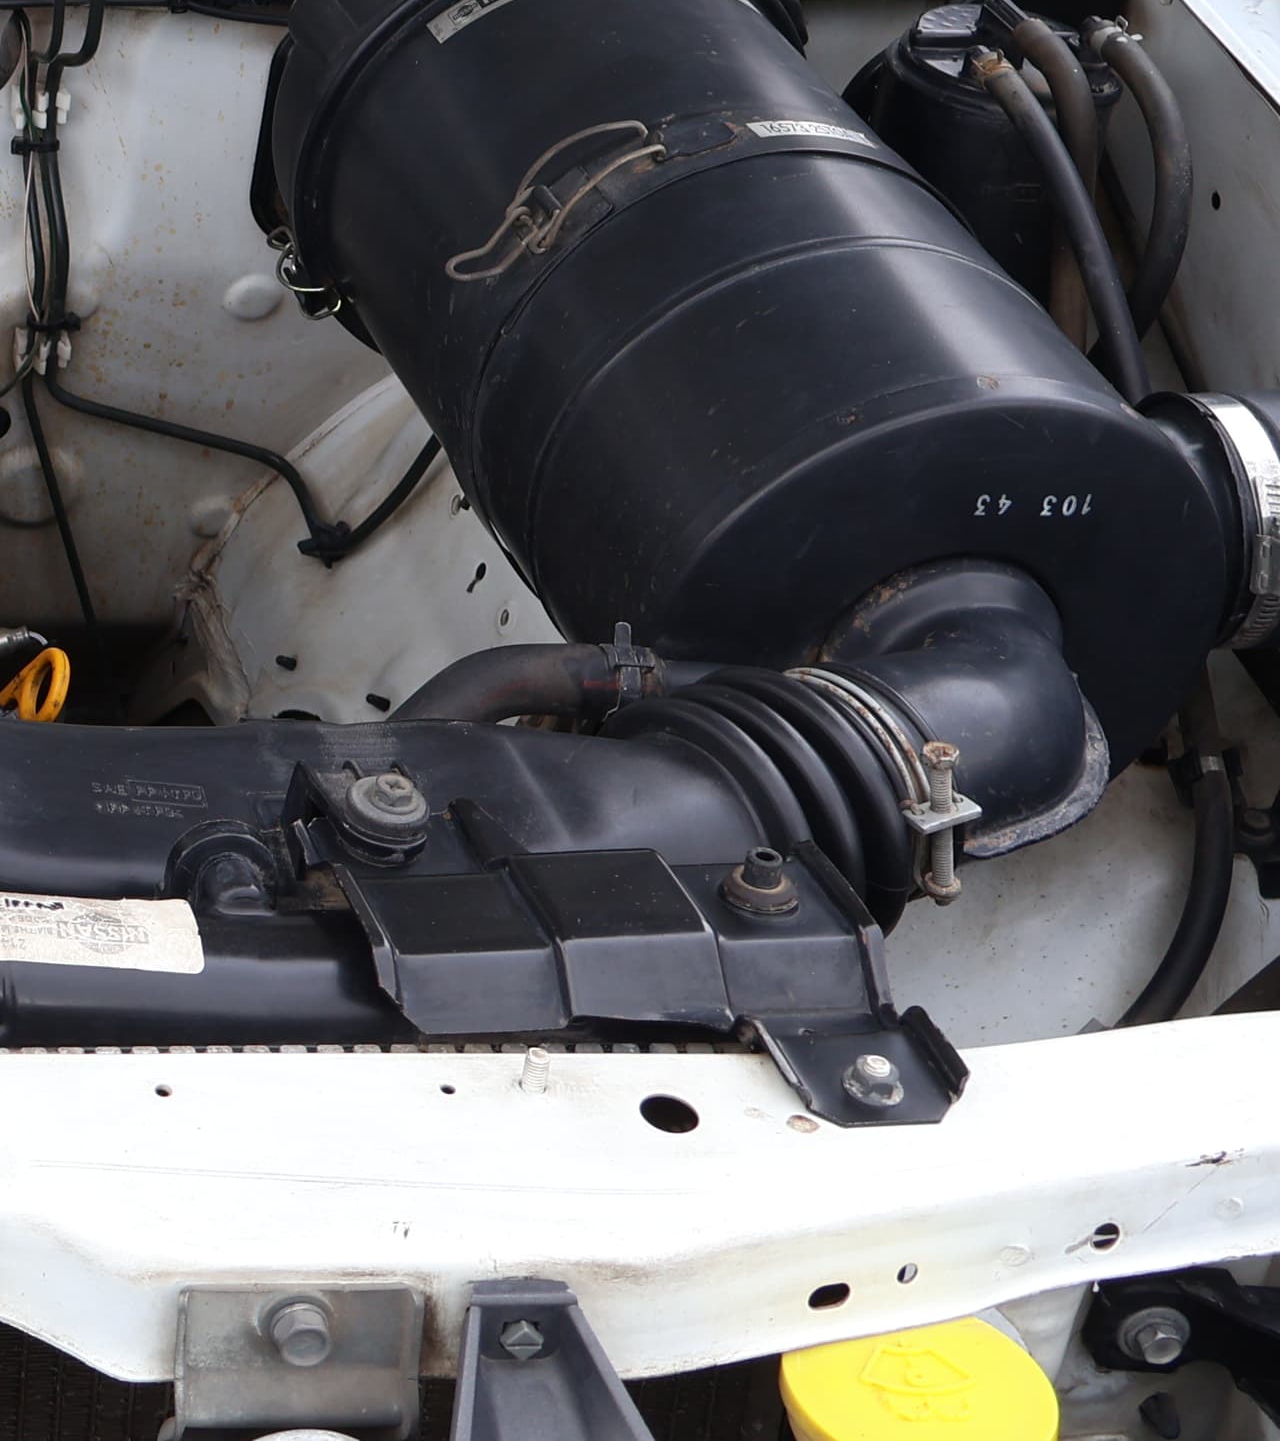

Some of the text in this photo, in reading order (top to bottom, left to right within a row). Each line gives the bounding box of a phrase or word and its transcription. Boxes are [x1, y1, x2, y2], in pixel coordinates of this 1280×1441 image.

[973, 493, 1092, 517] 103 43
[57, 920, 148, 944] NISSAN
